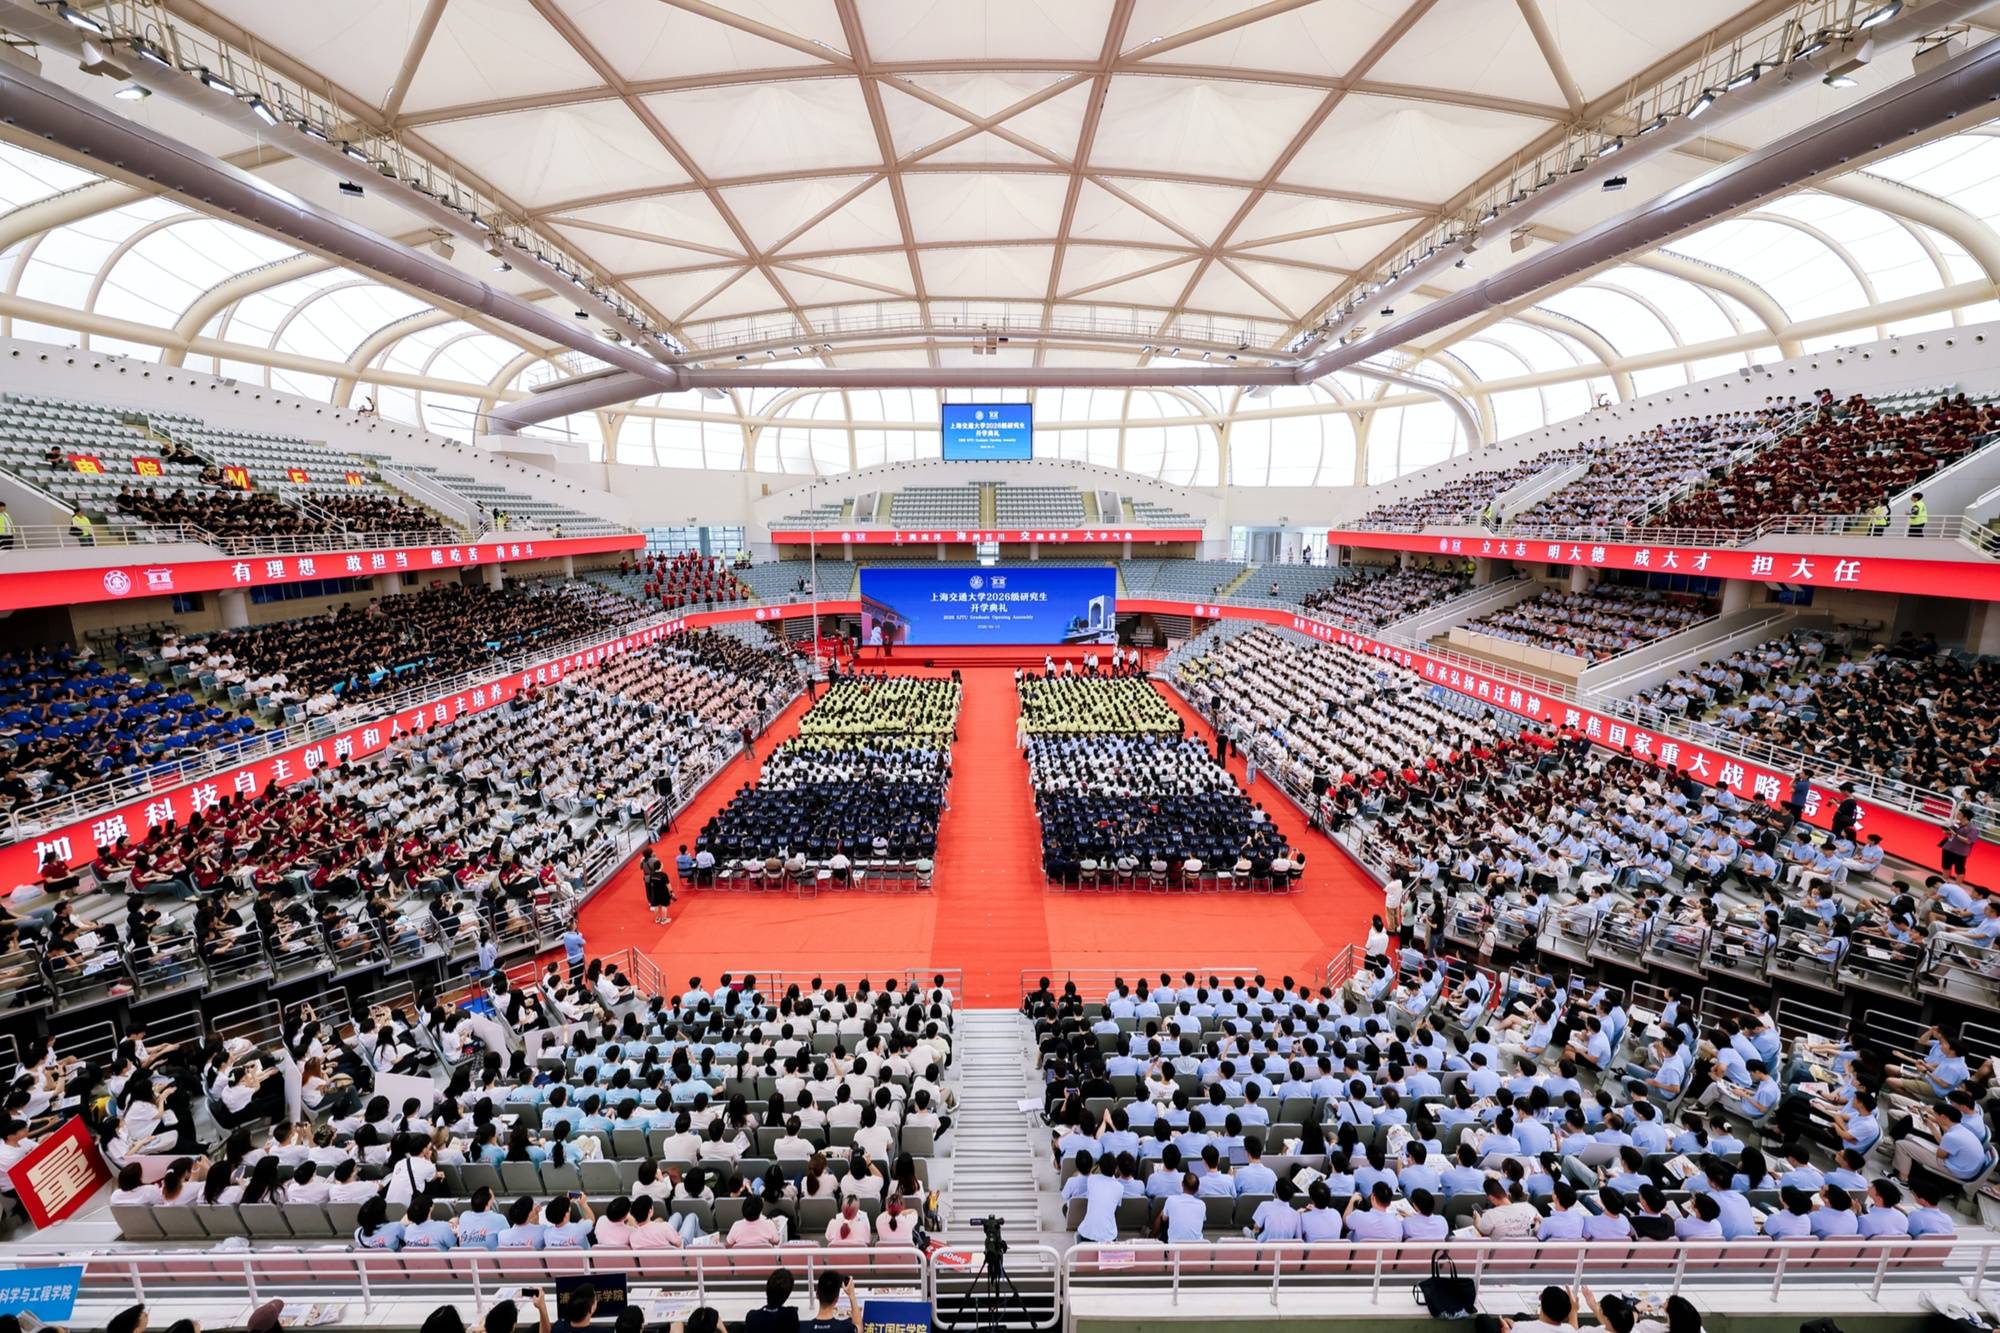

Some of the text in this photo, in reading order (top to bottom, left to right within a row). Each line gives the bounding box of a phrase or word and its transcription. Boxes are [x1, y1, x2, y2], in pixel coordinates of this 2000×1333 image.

[231, 544, 534, 583] 有理想 敢担当 能吃苦 肯奋斗
[1481, 540, 1862, 583] 立大志 明大德 成大才 担大任
[930, 592, 1048, 602] 上海交通大学2026级研究生
[970, 603, 1008, 613] 开学典礼
[0, 1284, 73, 1305] 科学与工程学院
